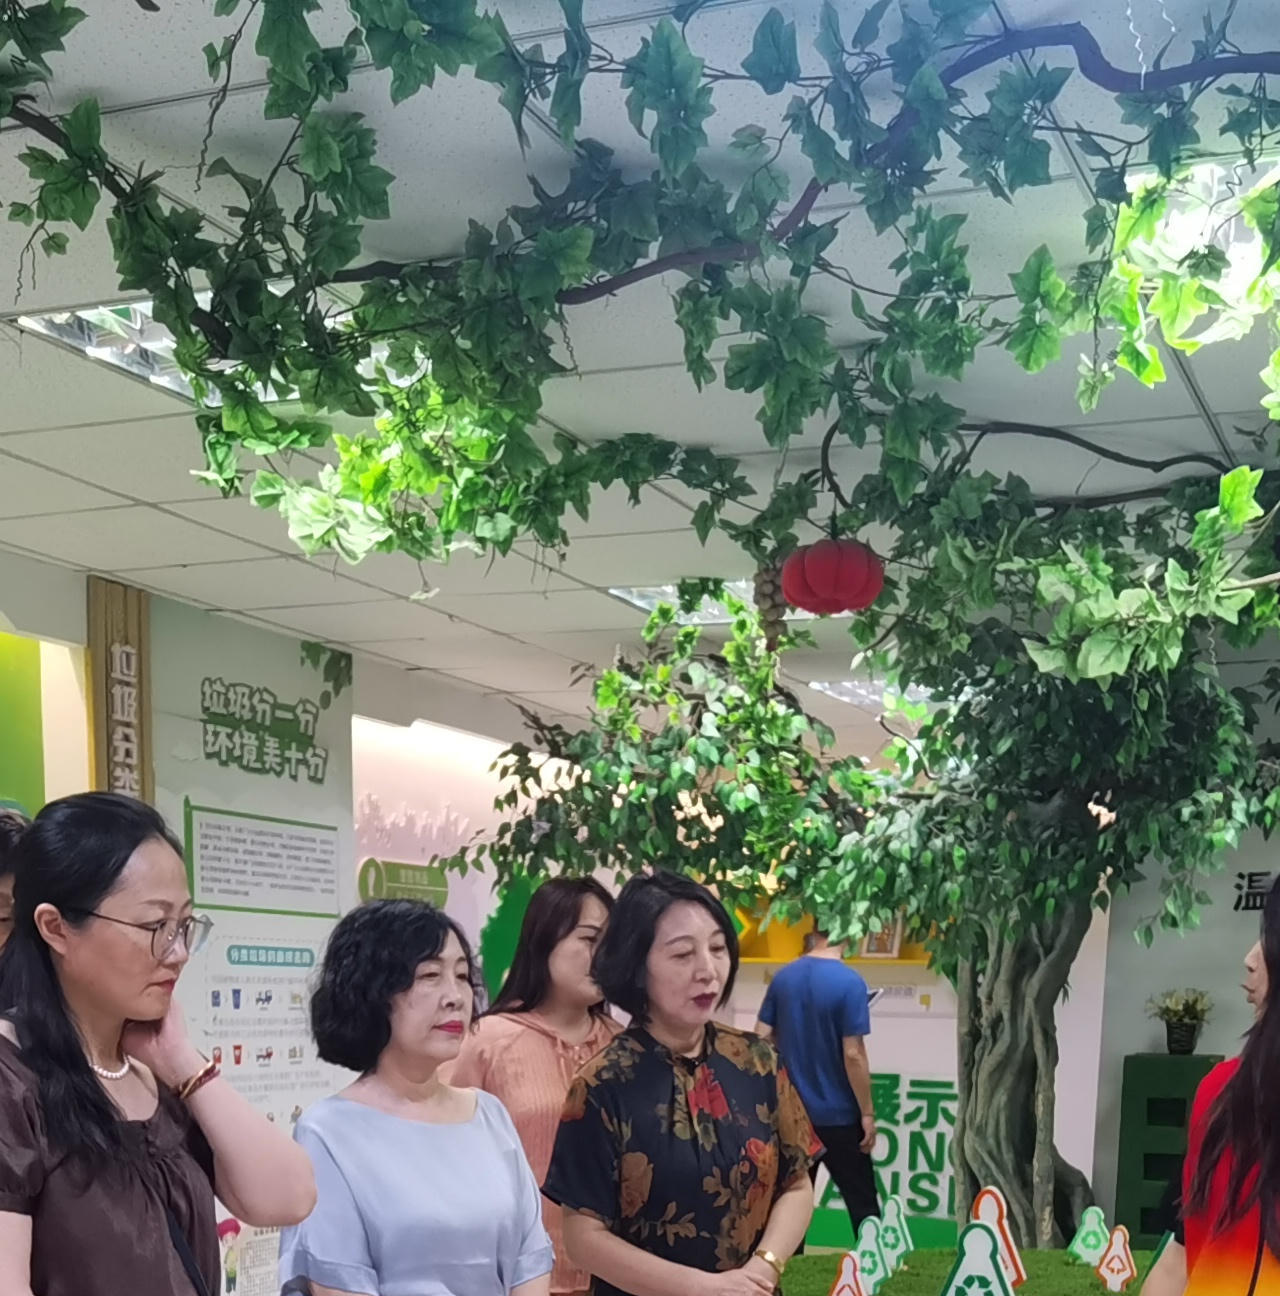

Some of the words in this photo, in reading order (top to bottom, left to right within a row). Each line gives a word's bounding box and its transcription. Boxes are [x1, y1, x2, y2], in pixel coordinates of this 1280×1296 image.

[203, 723, 328, 783] 环境美十分
